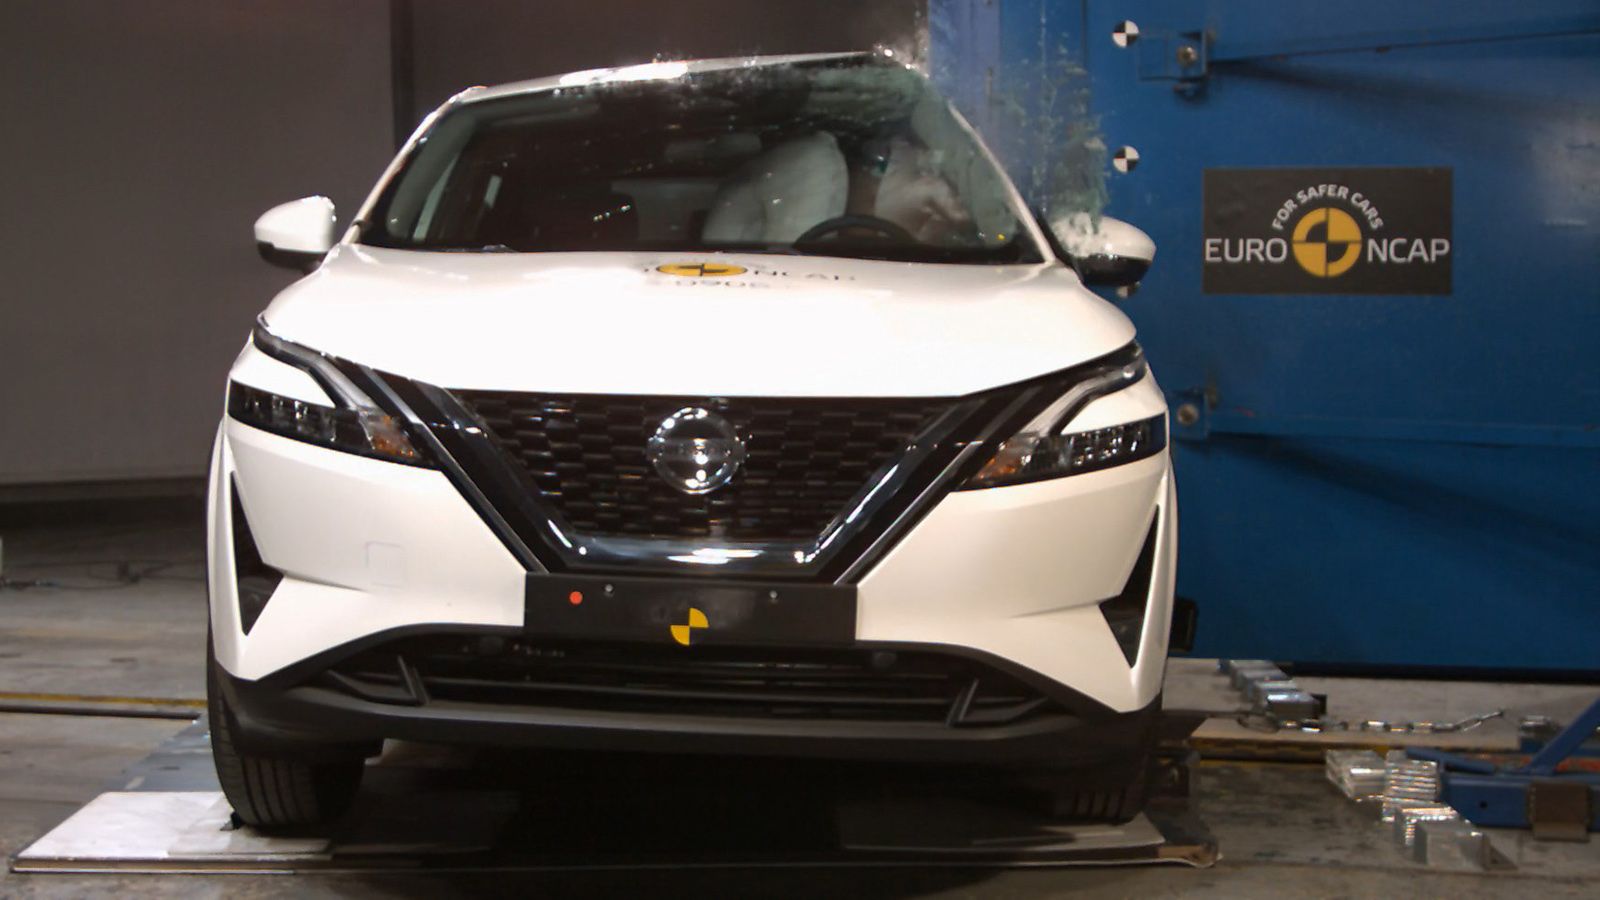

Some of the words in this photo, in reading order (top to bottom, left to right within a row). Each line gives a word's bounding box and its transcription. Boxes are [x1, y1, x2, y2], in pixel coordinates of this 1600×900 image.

[1272, 199, 1298, 231] FOR
[1297, 184, 1349, 204] SAFER
[1350, 193, 1384, 230] CARS
[1205, 238, 1288, 263] EURO
[1367, 238, 1450, 263] NCAP
